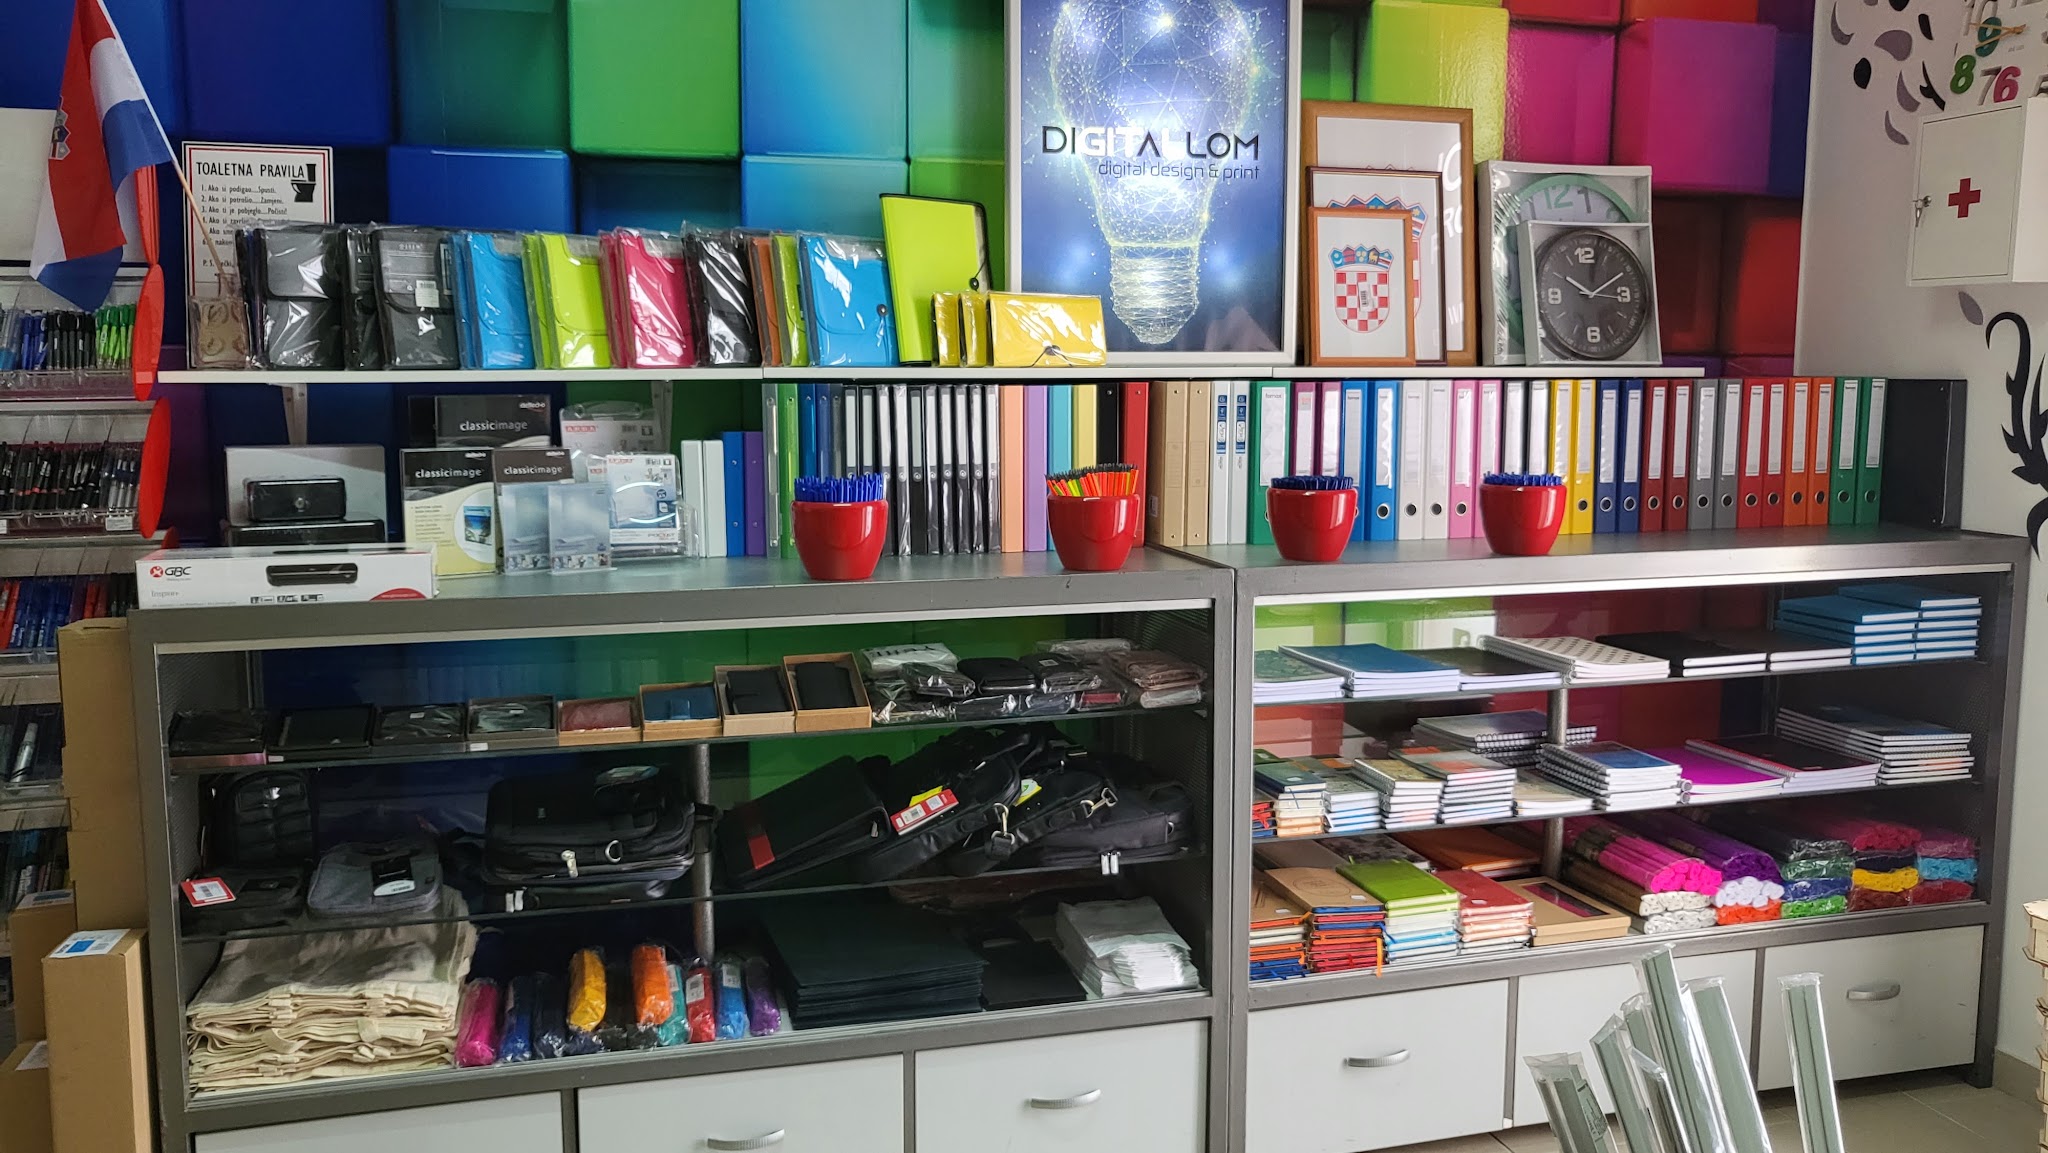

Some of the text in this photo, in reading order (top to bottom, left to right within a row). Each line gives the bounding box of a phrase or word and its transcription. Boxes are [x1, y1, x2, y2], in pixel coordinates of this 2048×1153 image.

[1975, 17, 2002, 57] 9
[1950, 55, 1976, 94] 8
[1978, 66, 2021, 105] 7 6
[196, 161, 305, 178] TOALETNA PRAVILA
[1098, 160, 1260, 181] digital design & print
[1544, 184, 1573, 210] 12
[1574, 247, 1595, 264] 12
[1616, 286, 1631, 303] 3
[1587, 326, 1601, 343] 6
[459, 419, 528, 432] classicimage
[415, 467, 483, 478] classicimage
[503, 465, 563, 476] classicimage
[164, 566, 192, 577] GBC
